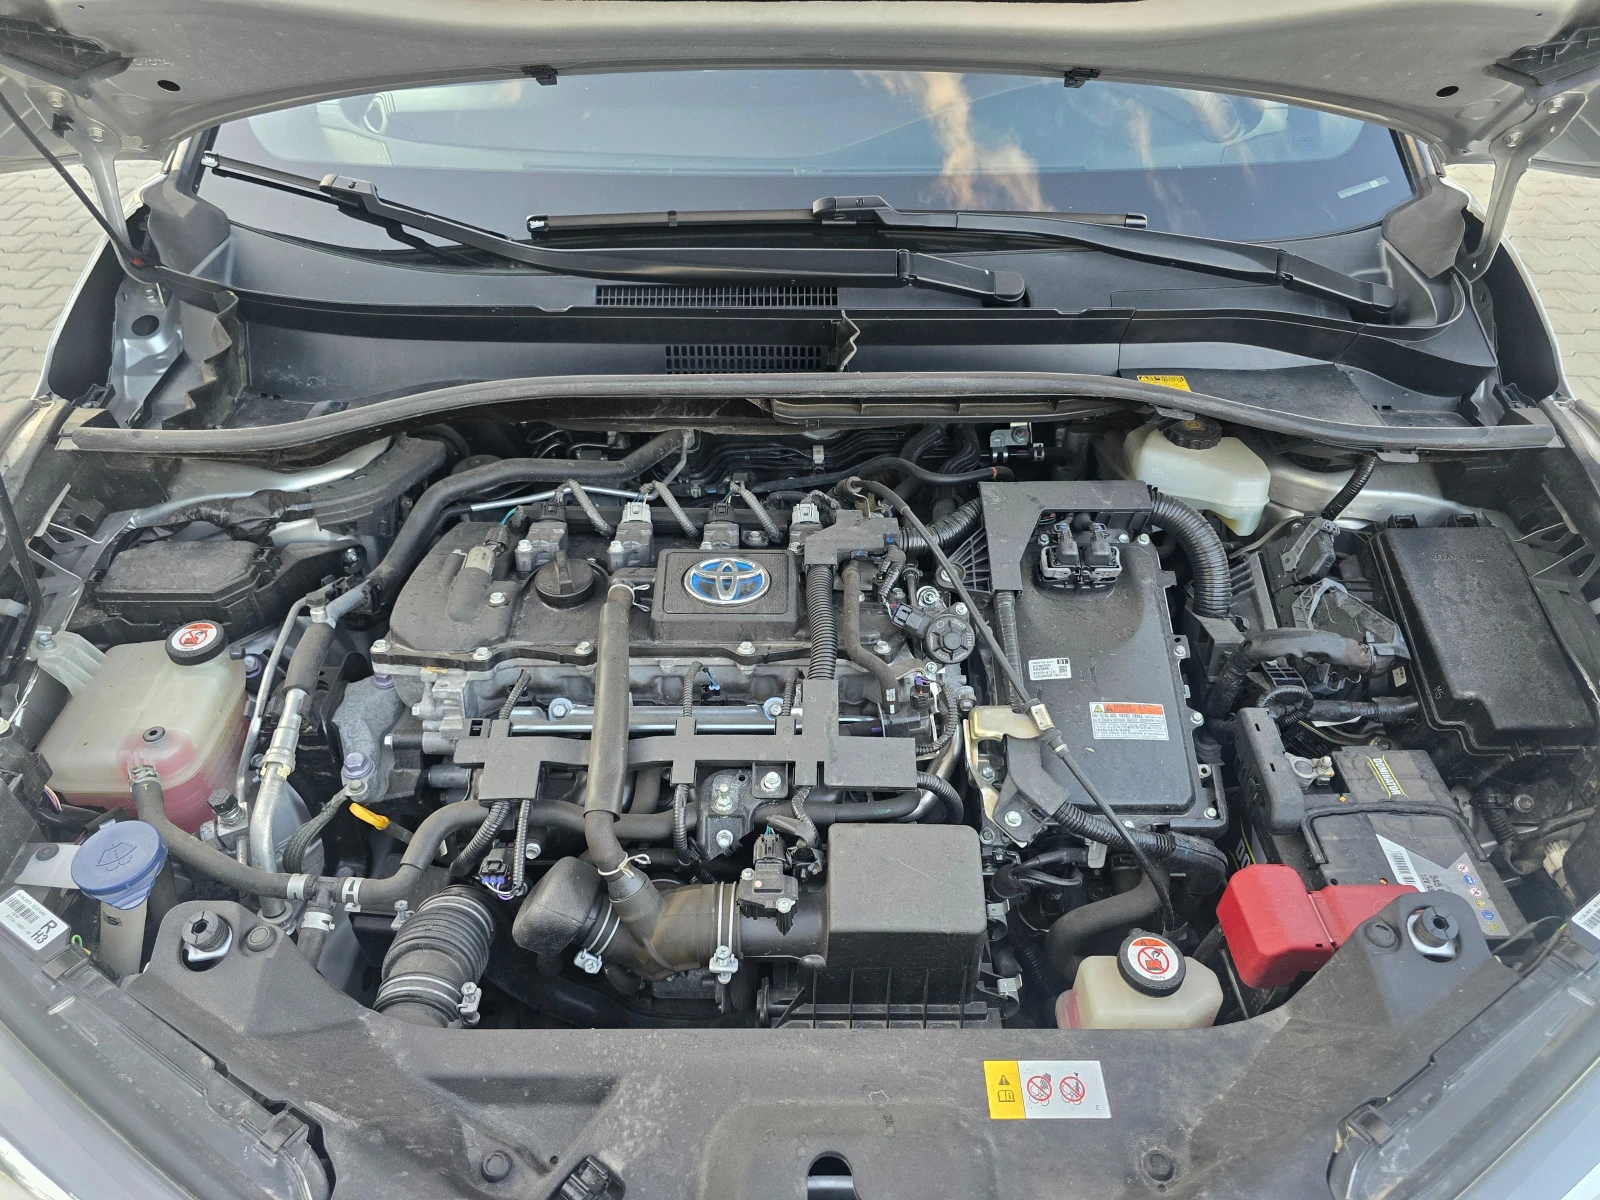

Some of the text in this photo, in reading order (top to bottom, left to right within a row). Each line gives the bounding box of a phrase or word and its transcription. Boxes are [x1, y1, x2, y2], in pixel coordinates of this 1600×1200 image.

[1372, 758, 1402, 795] DOMINATOR
[40, 919, 58, 935] R
[30, 929, 48, 944] H3
